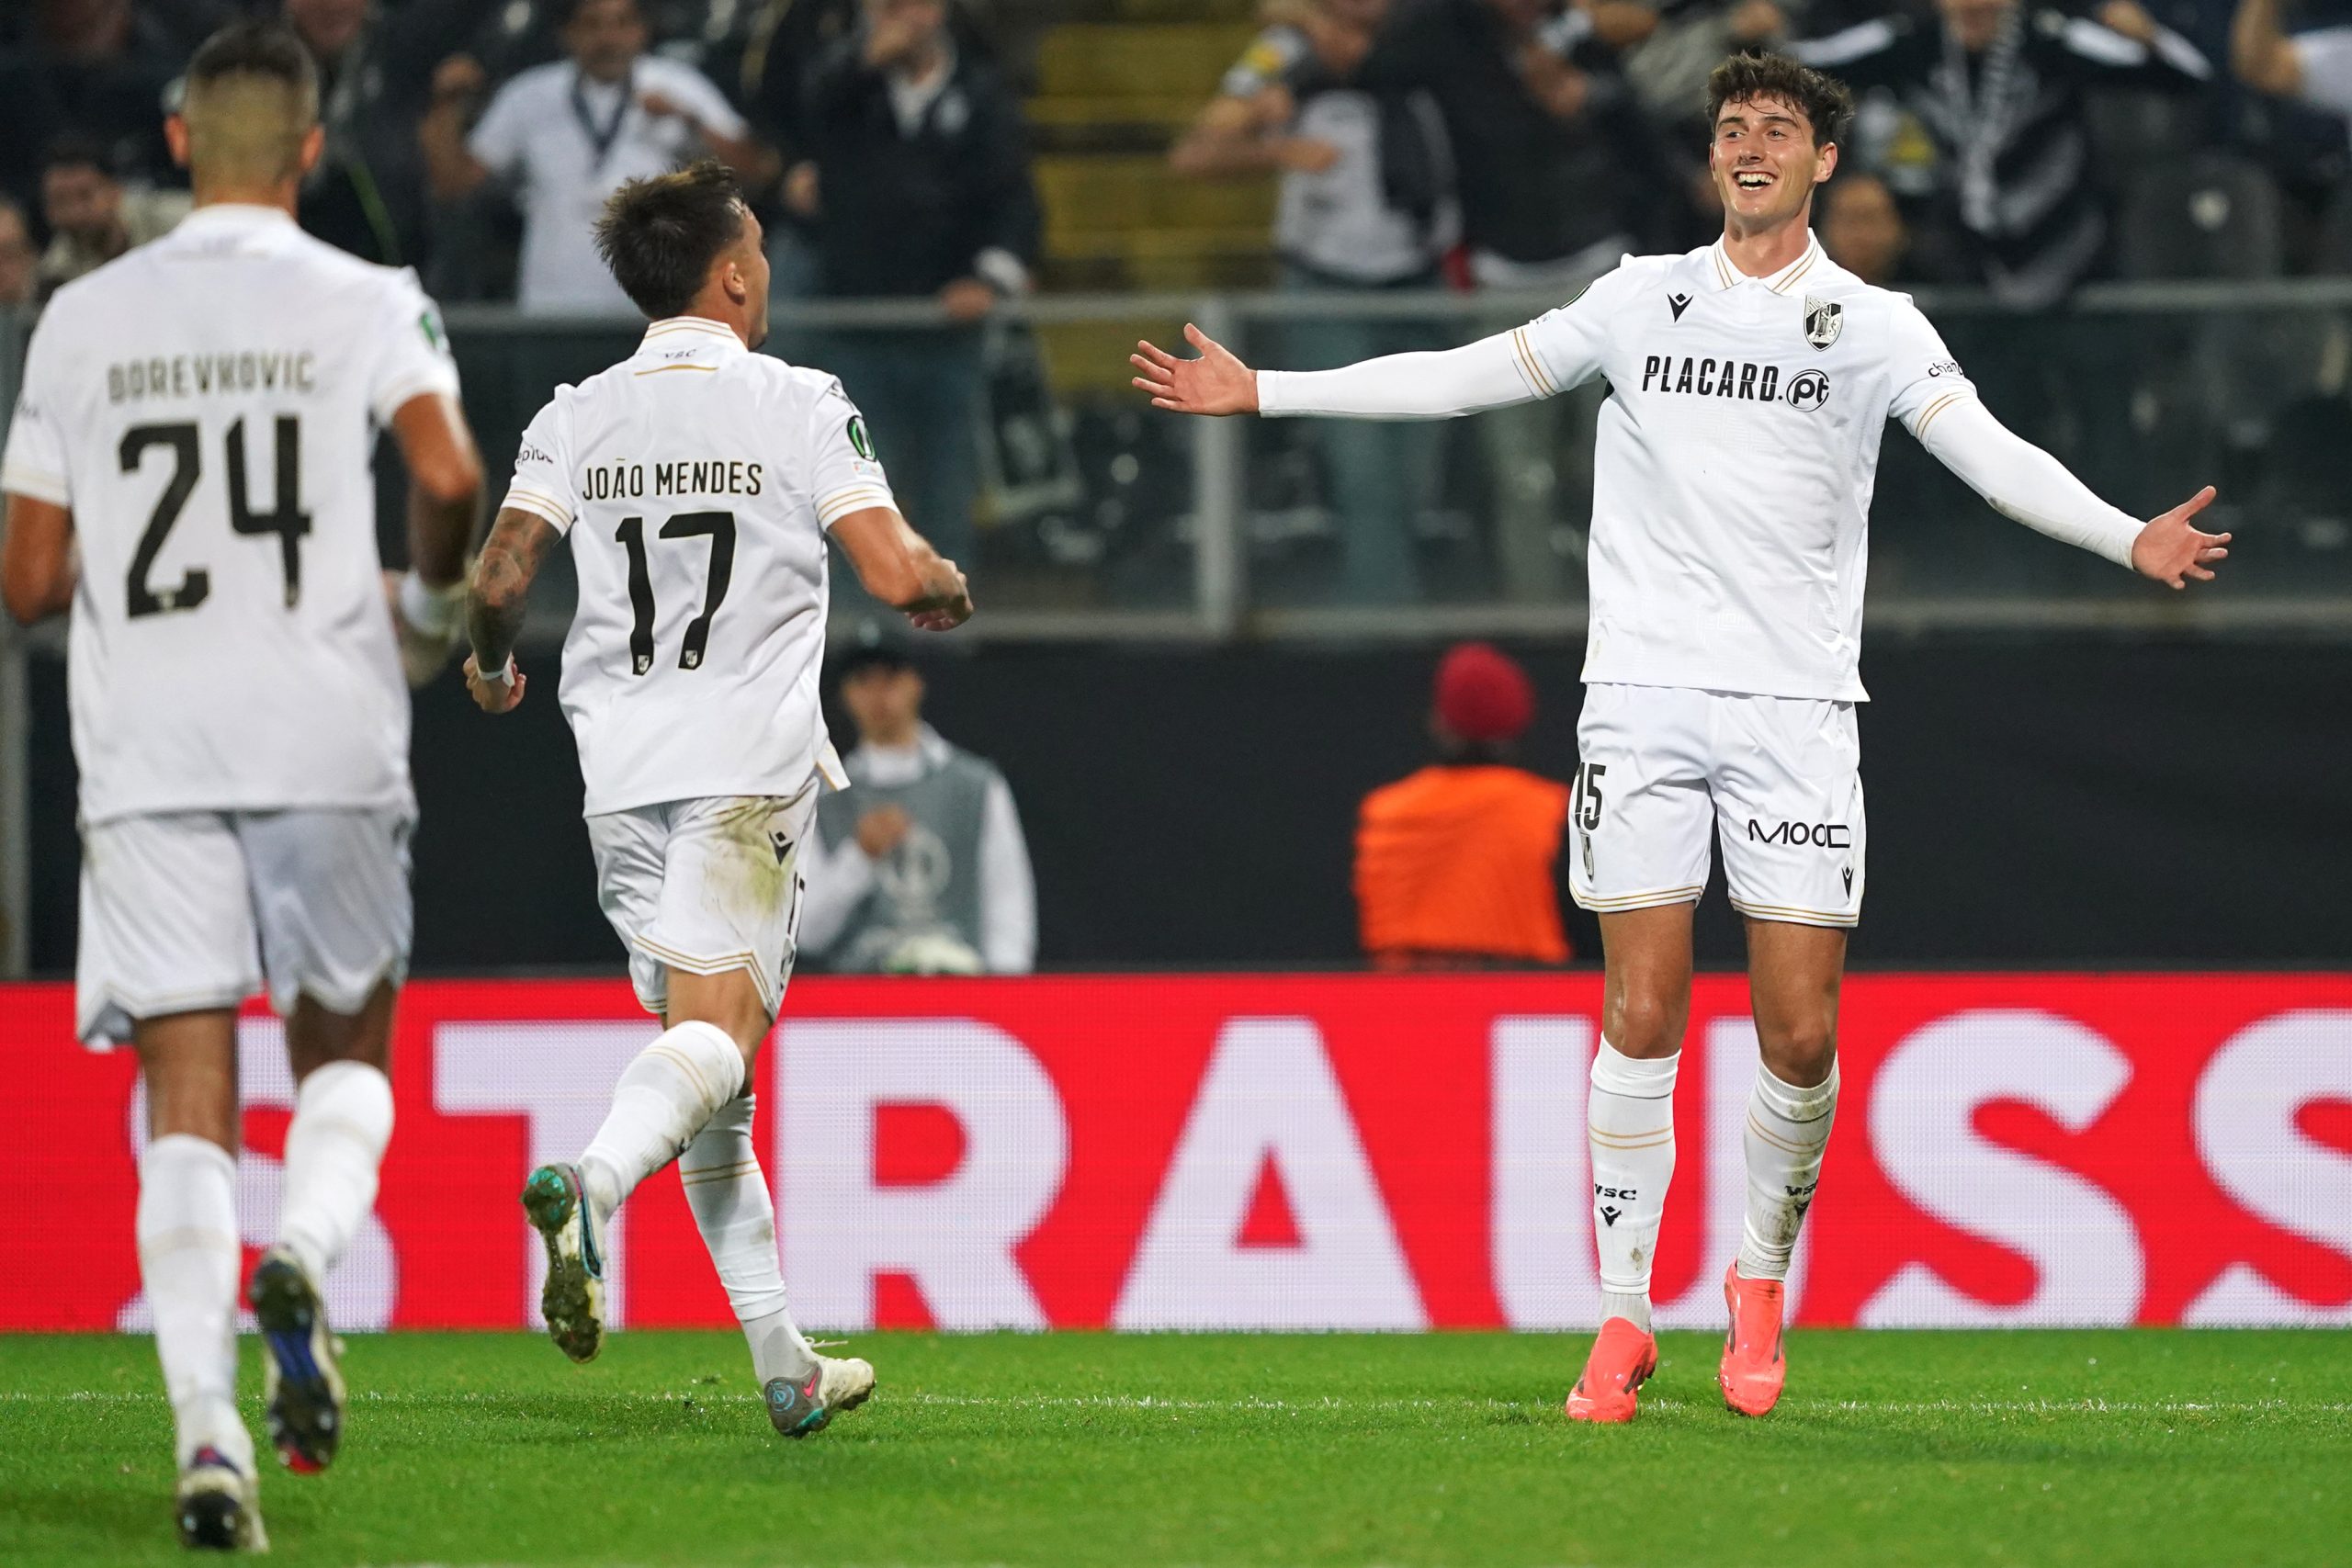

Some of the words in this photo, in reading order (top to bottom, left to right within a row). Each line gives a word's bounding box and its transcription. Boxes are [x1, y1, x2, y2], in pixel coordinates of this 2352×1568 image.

[582, 457, 643, 500] JOÃO
[655, 461, 763, 496] MENDES
[119, 412, 311, 621] 24
[615, 511, 737, 676] 17
[1575, 761, 1606, 830] 15
[1594, 1183, 1637, 1201] VSC
